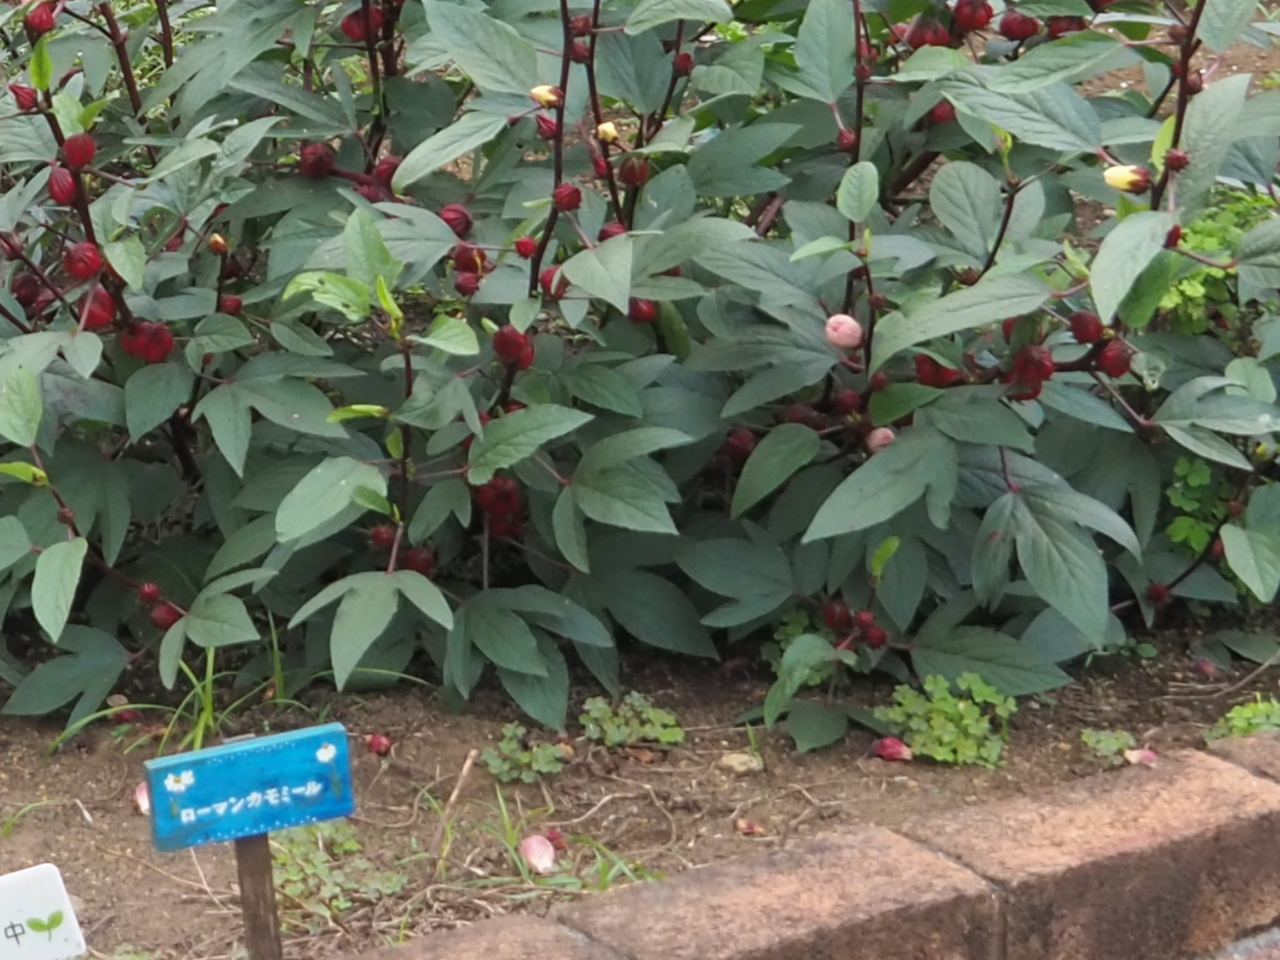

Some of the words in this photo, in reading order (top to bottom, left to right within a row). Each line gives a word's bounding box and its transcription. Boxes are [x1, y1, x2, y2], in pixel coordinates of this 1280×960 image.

[180, 781, 322, 824] ローマンカモミール
